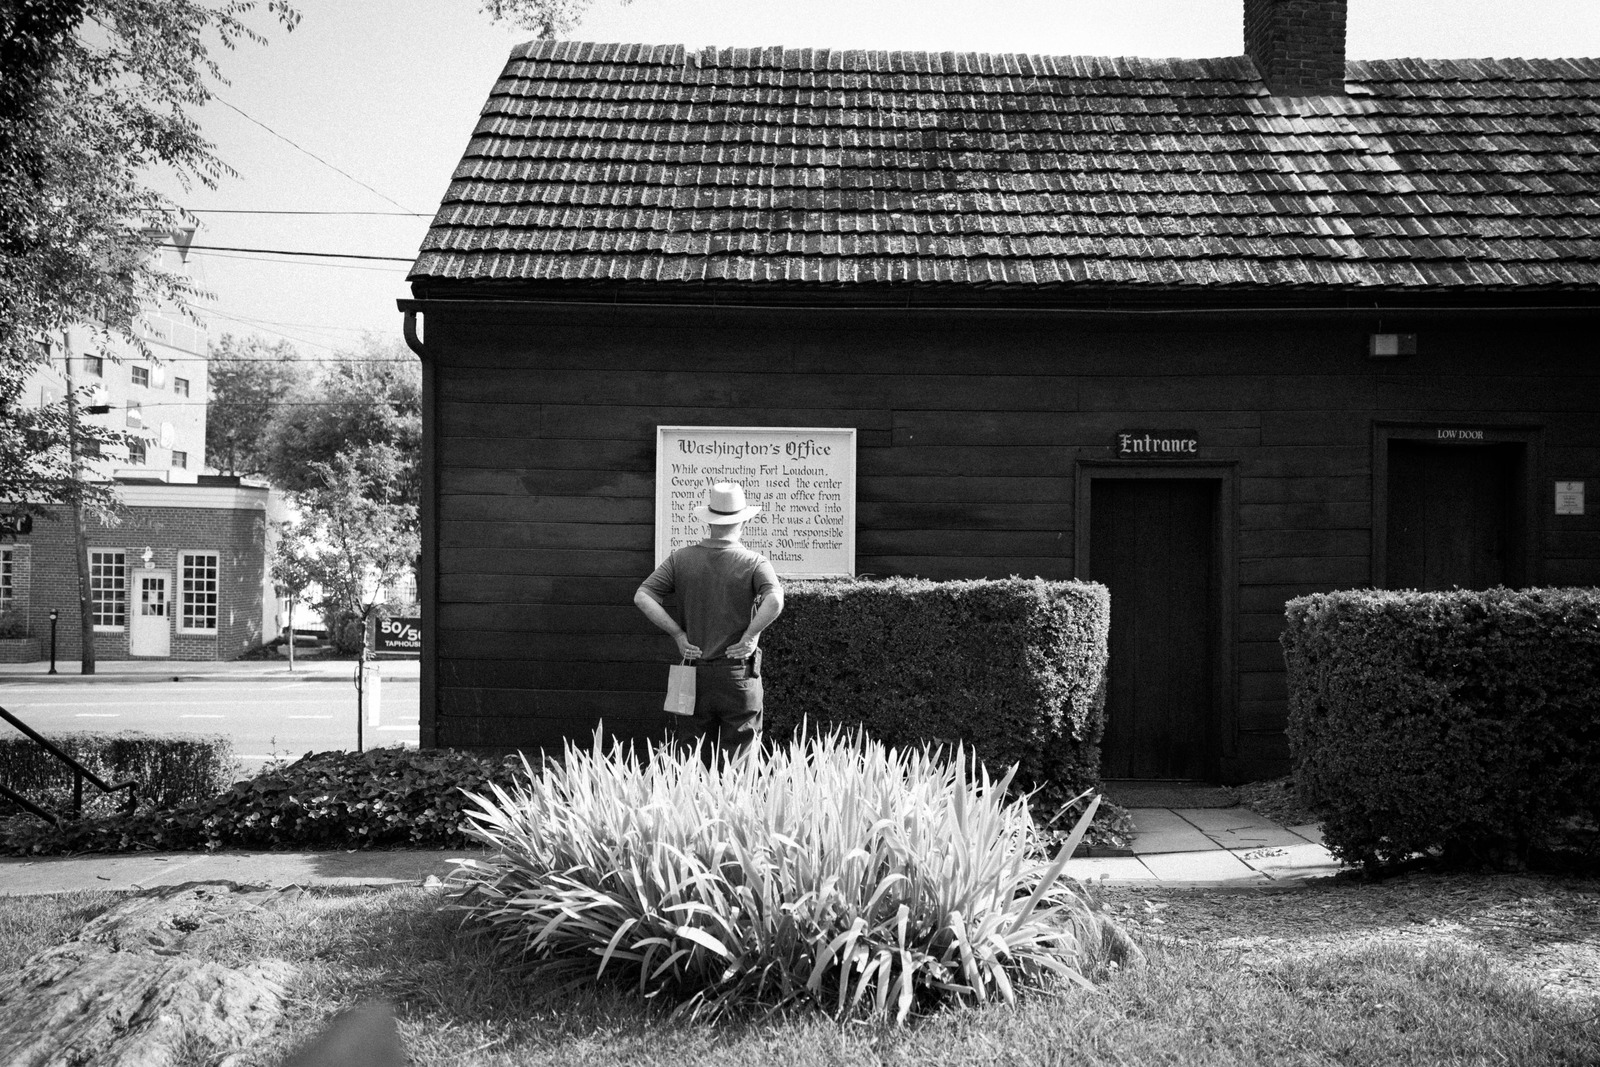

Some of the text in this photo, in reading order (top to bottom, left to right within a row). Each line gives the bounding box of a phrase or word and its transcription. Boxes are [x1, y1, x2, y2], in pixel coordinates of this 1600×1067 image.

[1438, 430, 1484, 439] LOW DOOR
[678, 439, 831, 461] Washington's Office
[1119, 434, 1197, 453] Entrance
[671, 463, 698, 474] While
[701, 464, 756, 477] constructing
[760, 465, 778, 475] Fort
[671, 476, 704, 490] George
[766, 477, 790, 488] used
[796, 477, 810, 488] the
[813, 478, 842, 489] center
[671, 491, 695, 499] room
[697, 488, 706, 499] of
[763, 492, 774, 500] as
[776, 492, 787, 500] an
[790, 489, 815, 500] office
[818, 490, 841, 501] from
[671, 500, 685, 511] the
[775, 502, 786, 512] he
[790, 502, 820, 512] moved
[824, 503, 842, 513] into
[671, 512, 686, 523] the
[772, 513, 785, 524] He
[787, 517, 804, 525] was
[805, 517, 811, 525] a
[814, 514, 844, 526] Colonel
[671, 525, 680, 535] in
[684, 525, 699, 535] the
[771, 527, 788, 537] and
[793, 528, 843, 541] responsible
[671, 536, 683, 547] for
[812, 539, 843, 550] frontier
[769, 550, 804, 562] Indians.
